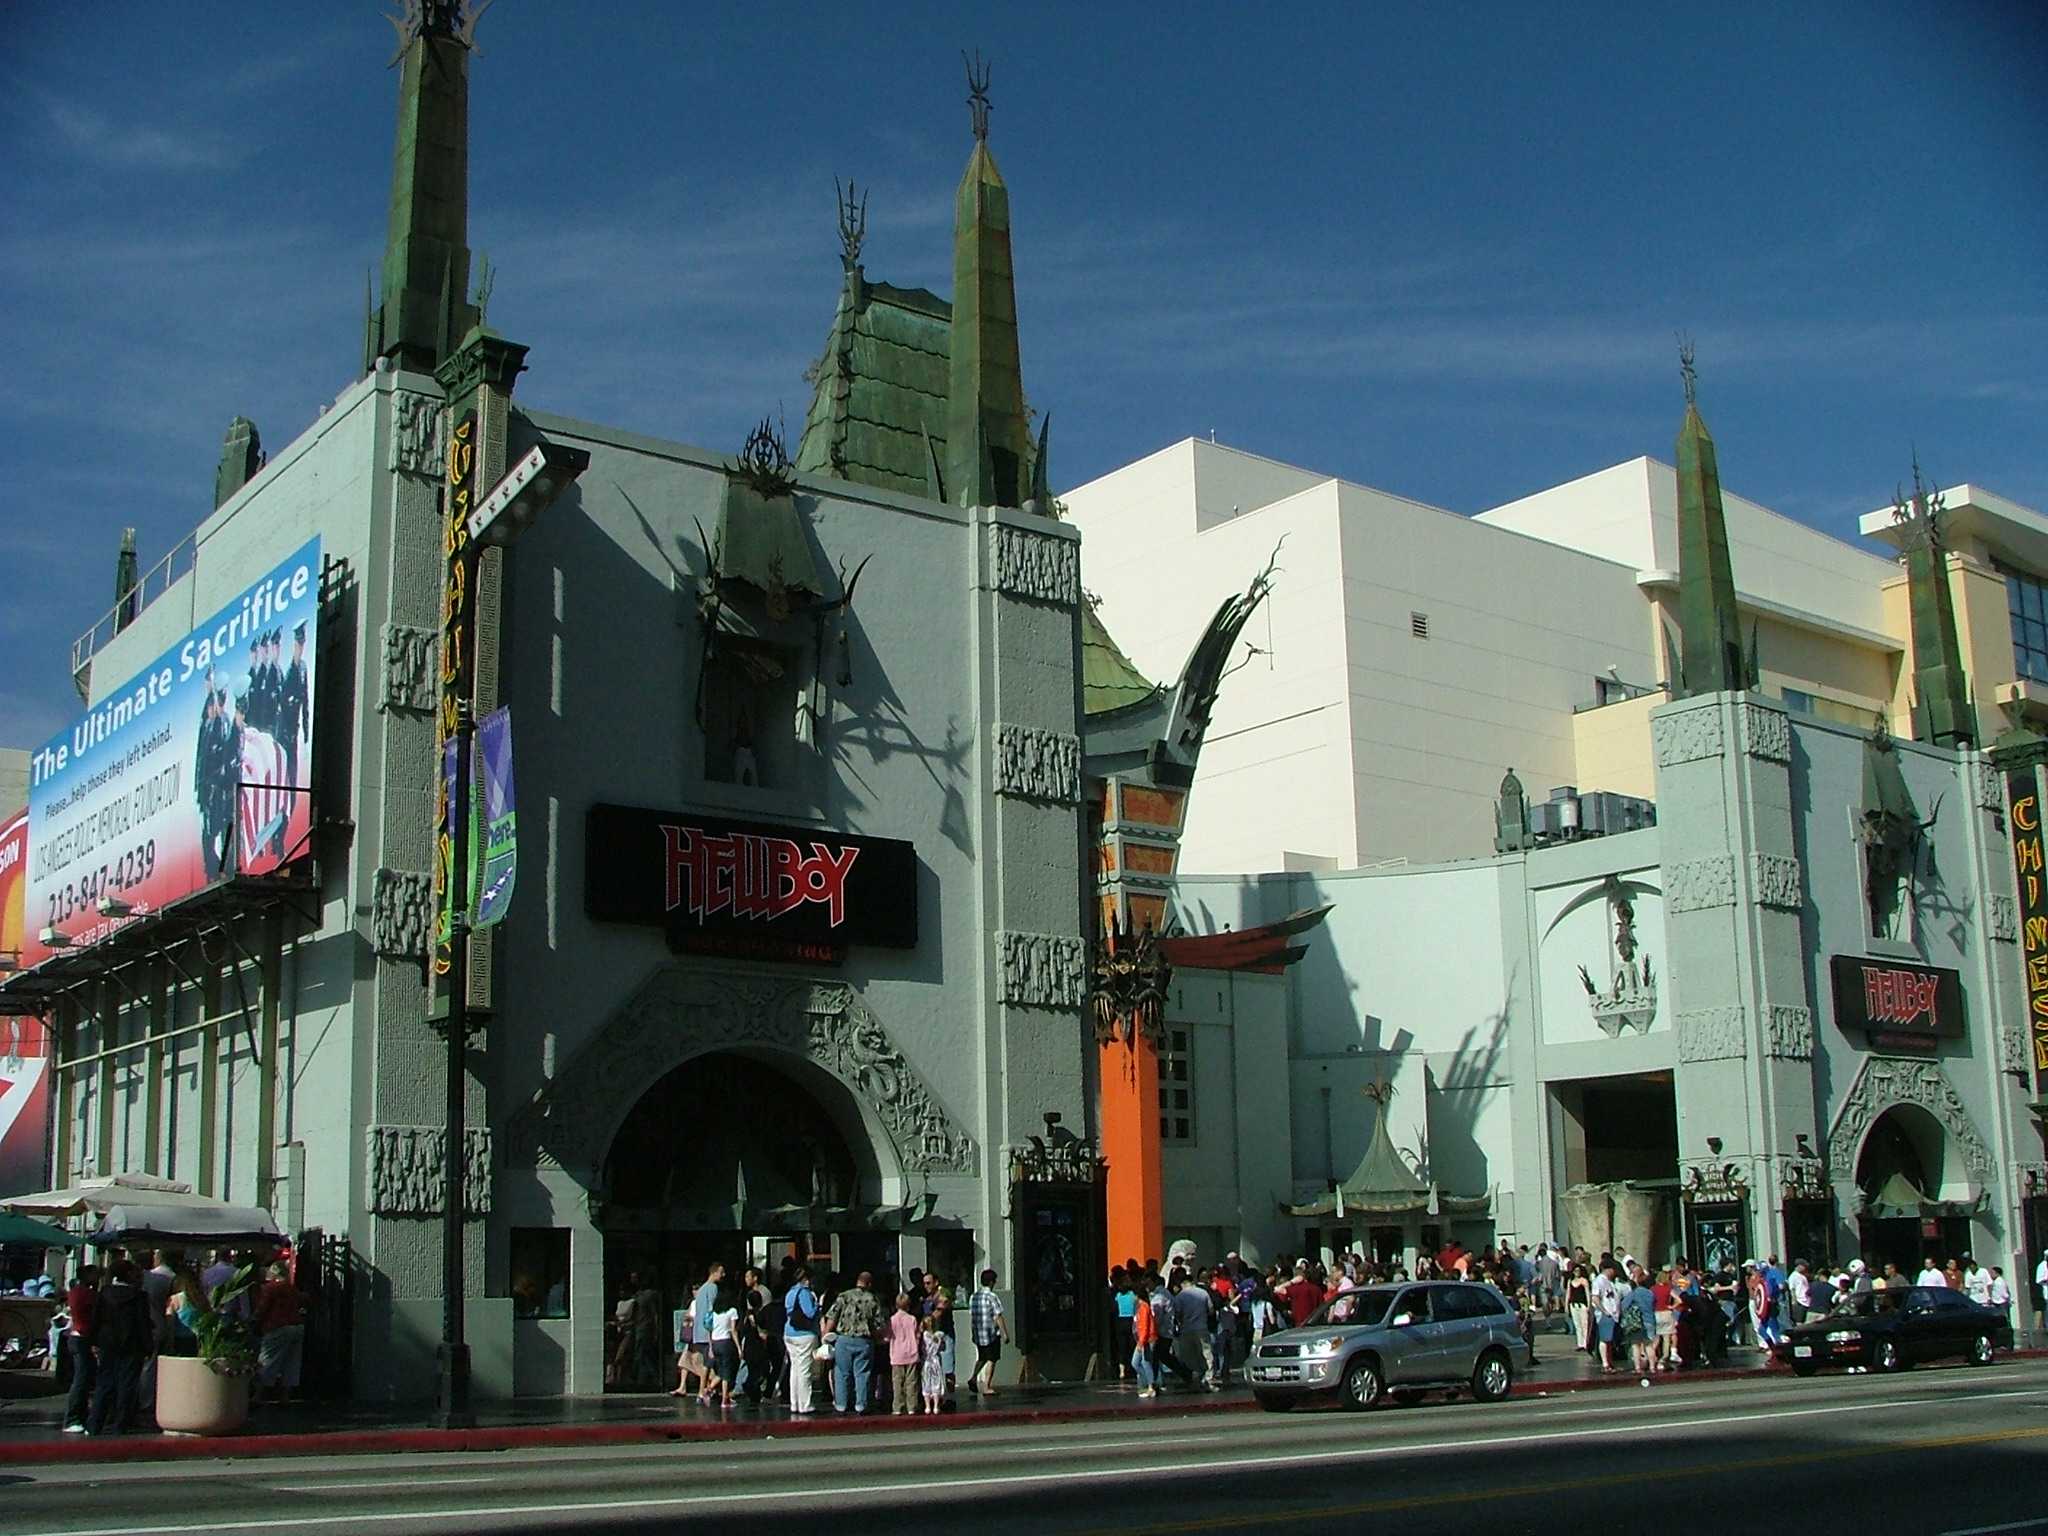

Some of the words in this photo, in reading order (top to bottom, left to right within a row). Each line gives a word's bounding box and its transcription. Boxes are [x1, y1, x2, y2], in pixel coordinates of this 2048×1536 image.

[33, 745, 68, 787] The
[74, 667, 172, 758] Ultimate
[180, 565, 309, 683] Sacrifice
[108, 757, 125, 778] they
[126, 744, 141, 769] left
[48, 839, 156, 926] 213-847-4239
[658, 824, 860, 928] HELLBOY
[1861, 967, 1939, 1026] HELLBOY
